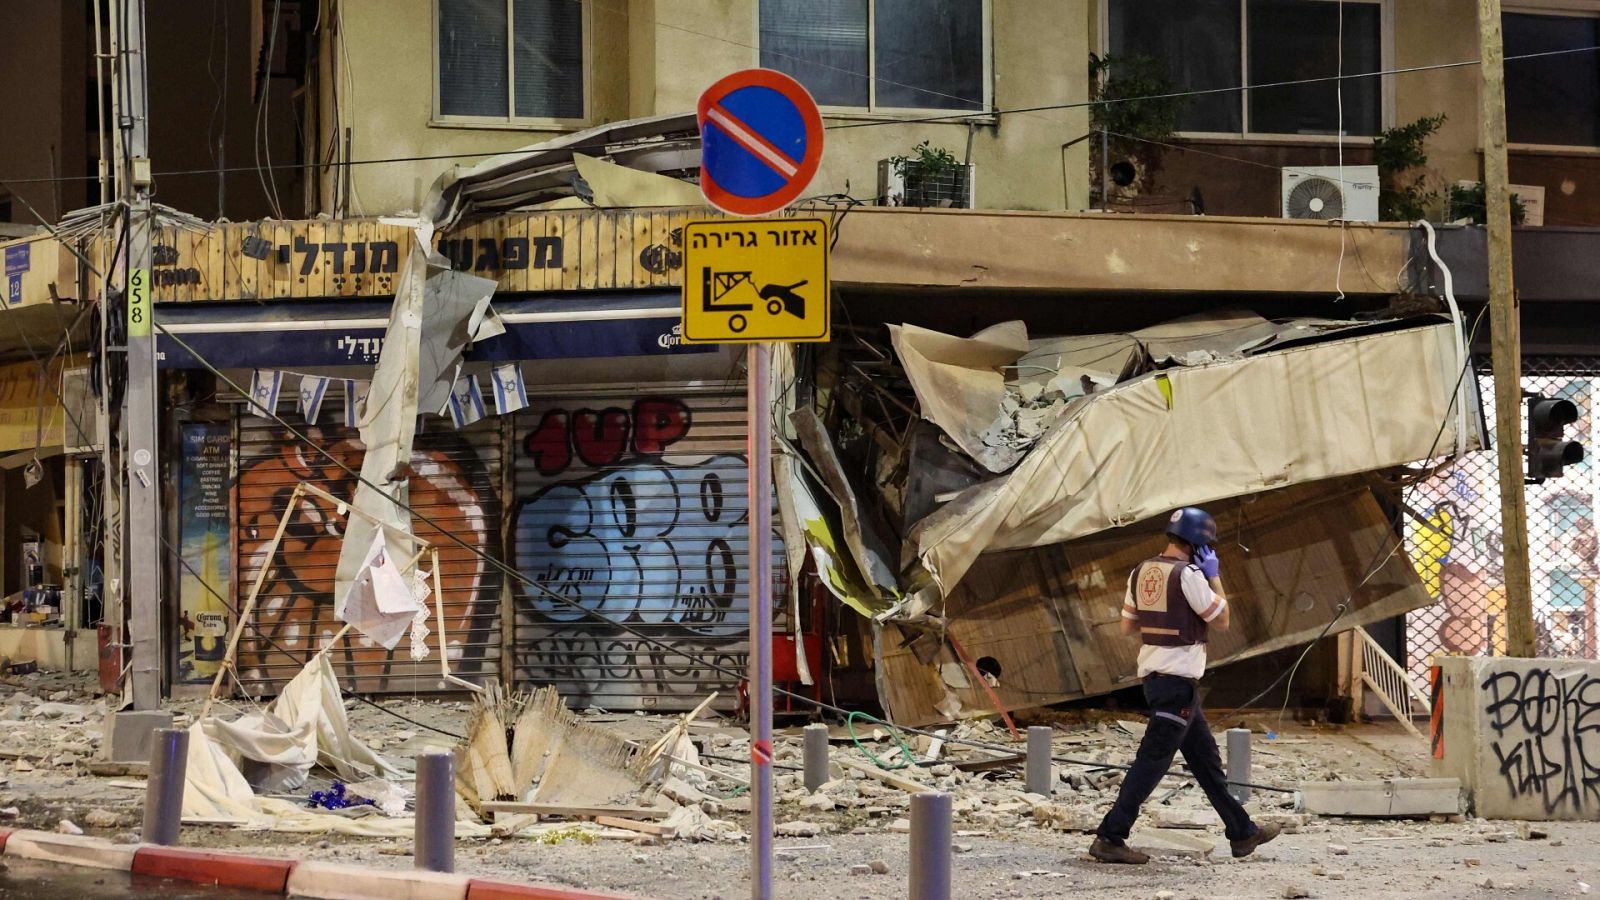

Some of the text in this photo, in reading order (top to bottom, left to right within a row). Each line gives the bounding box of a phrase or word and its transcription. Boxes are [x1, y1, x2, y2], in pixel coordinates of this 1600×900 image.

[693, 230, 817, 249] אזור גרירה
[11, 281, 20, 297] 12
[131, 269, 142, 323] 658
[657, 333, 682, 349] Cor
[206, 435, 231, 443] CARD
[203, 446, 220, 454] ATM
[196, 613, 222, 622] Corona
